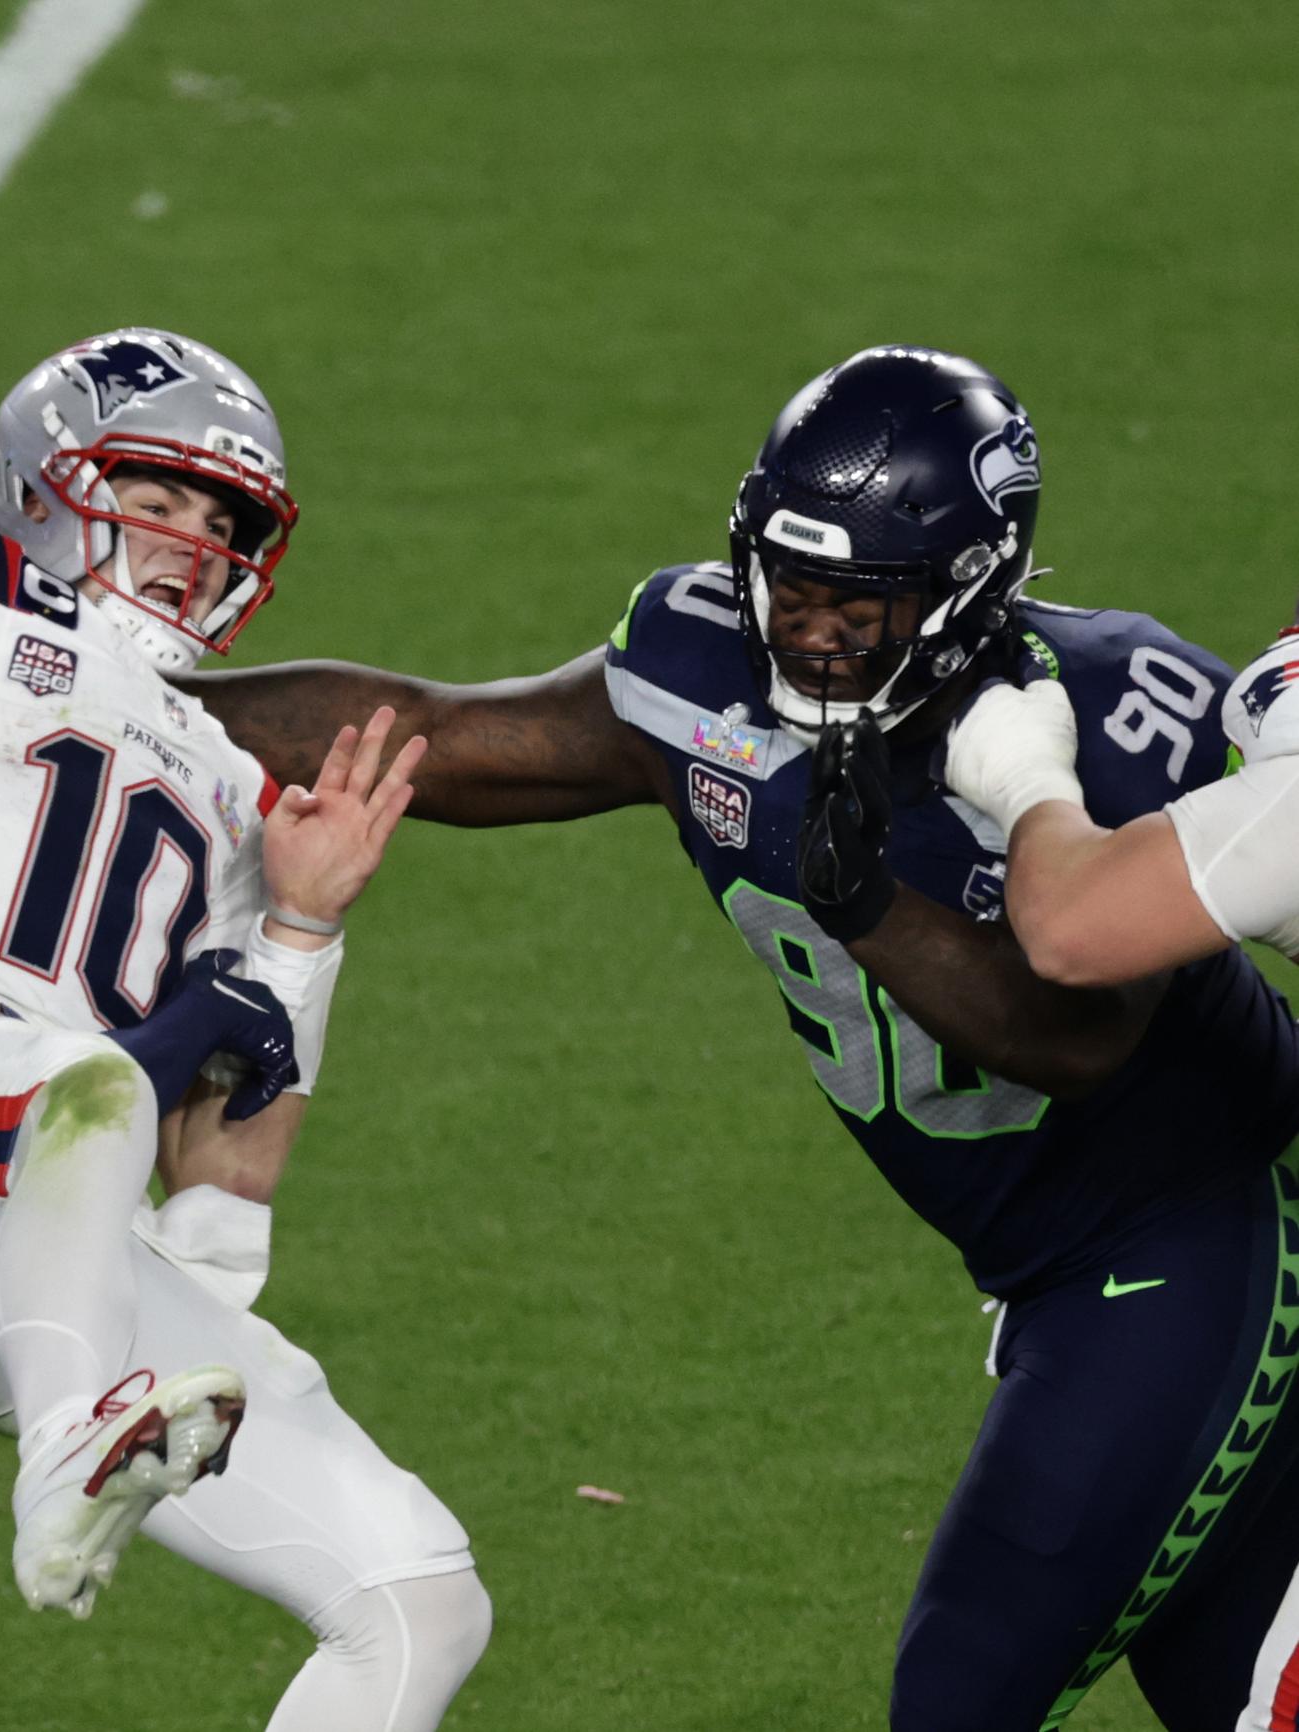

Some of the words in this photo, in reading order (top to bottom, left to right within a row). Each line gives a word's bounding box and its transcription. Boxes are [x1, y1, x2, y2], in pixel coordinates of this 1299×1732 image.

[781, 520, 825, 545] SEAHAWKS
[18, 637, 73, 669] USA
[9, 661, 72, 695] 250
[1103, 646, 1216, 785] 90
[694, 772, 744, 814] USA
[693, 799, 744, 843] 250
